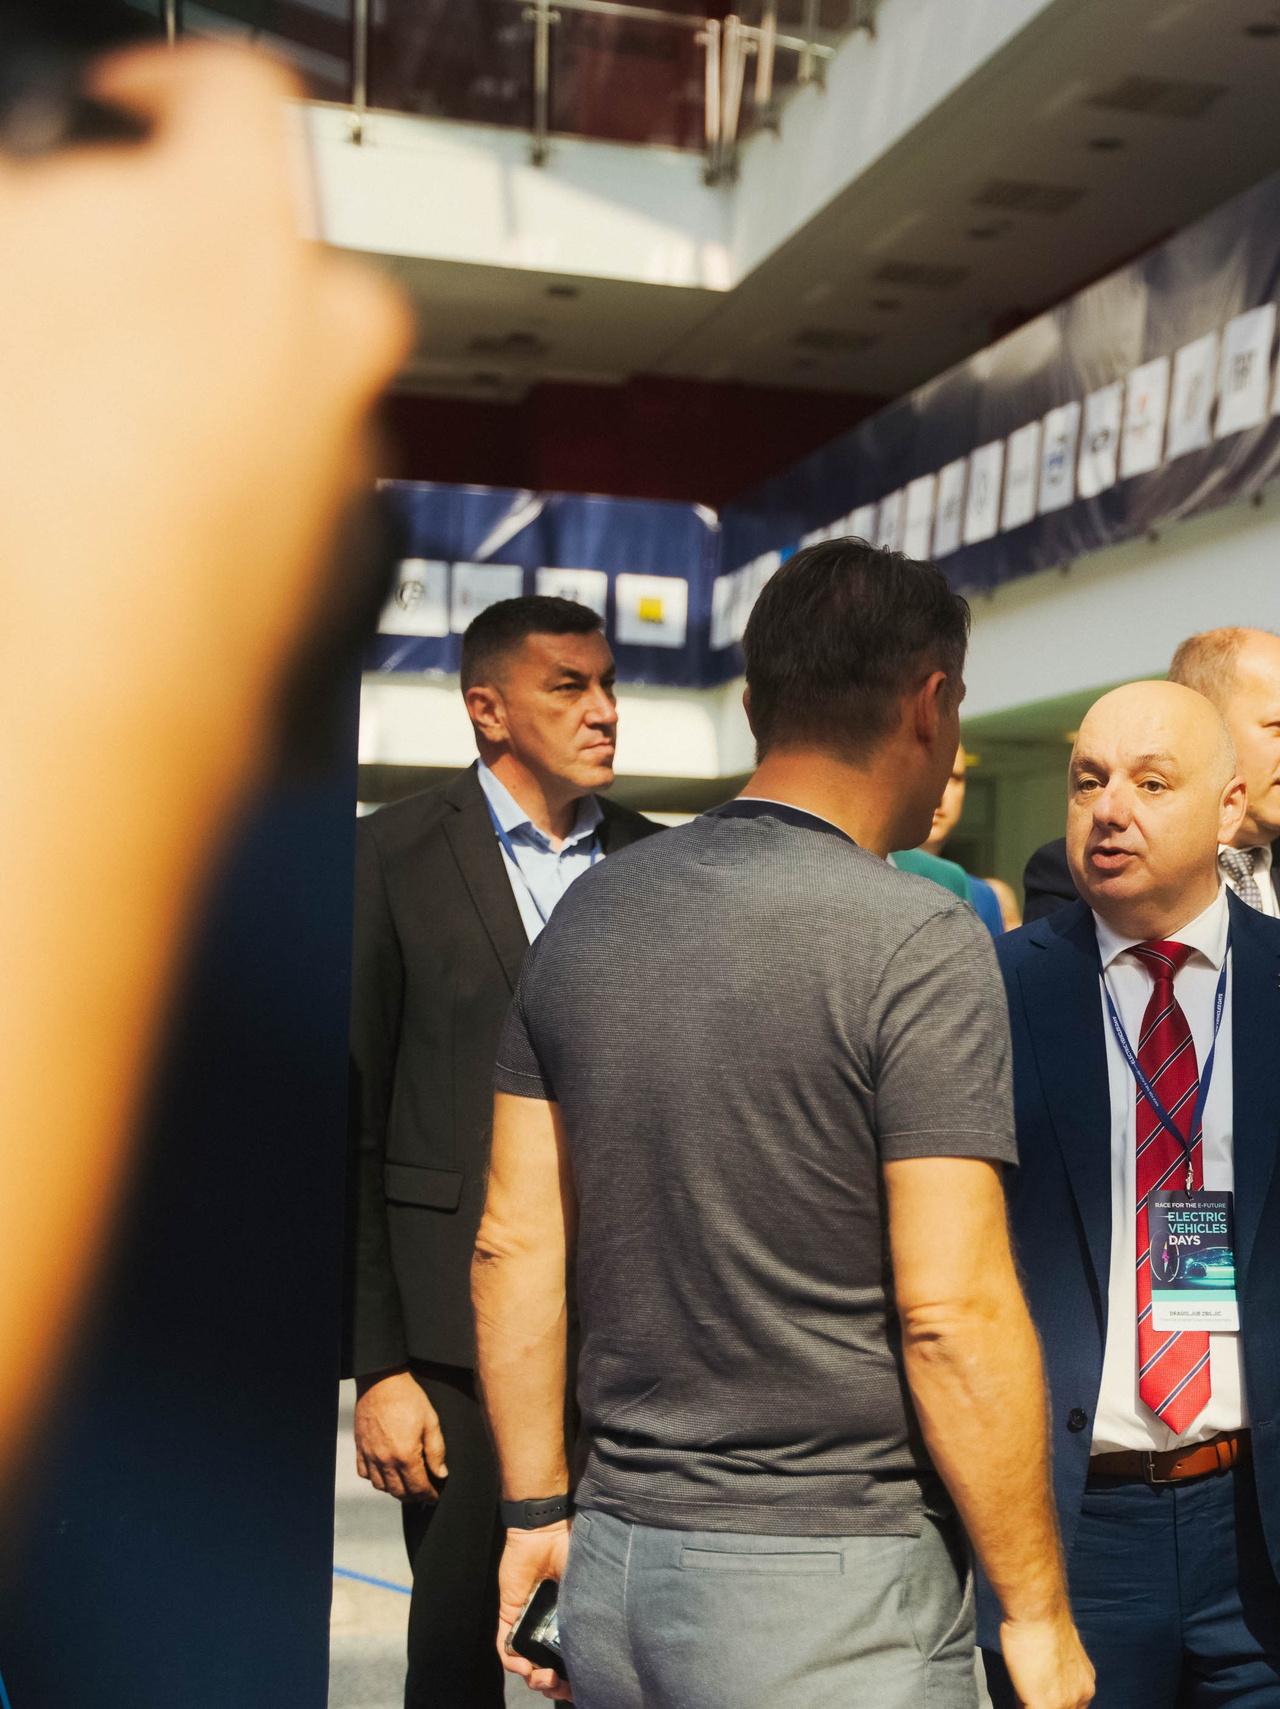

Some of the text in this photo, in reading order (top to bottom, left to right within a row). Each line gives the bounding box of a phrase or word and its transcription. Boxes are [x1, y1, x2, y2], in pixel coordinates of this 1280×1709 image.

[1168, 1212, 1226, 1222] ELECTRIC
[1168, 1224, 1228, 1234] VEHICLES
[1168, 1234, 1201, 1245] DAYS
